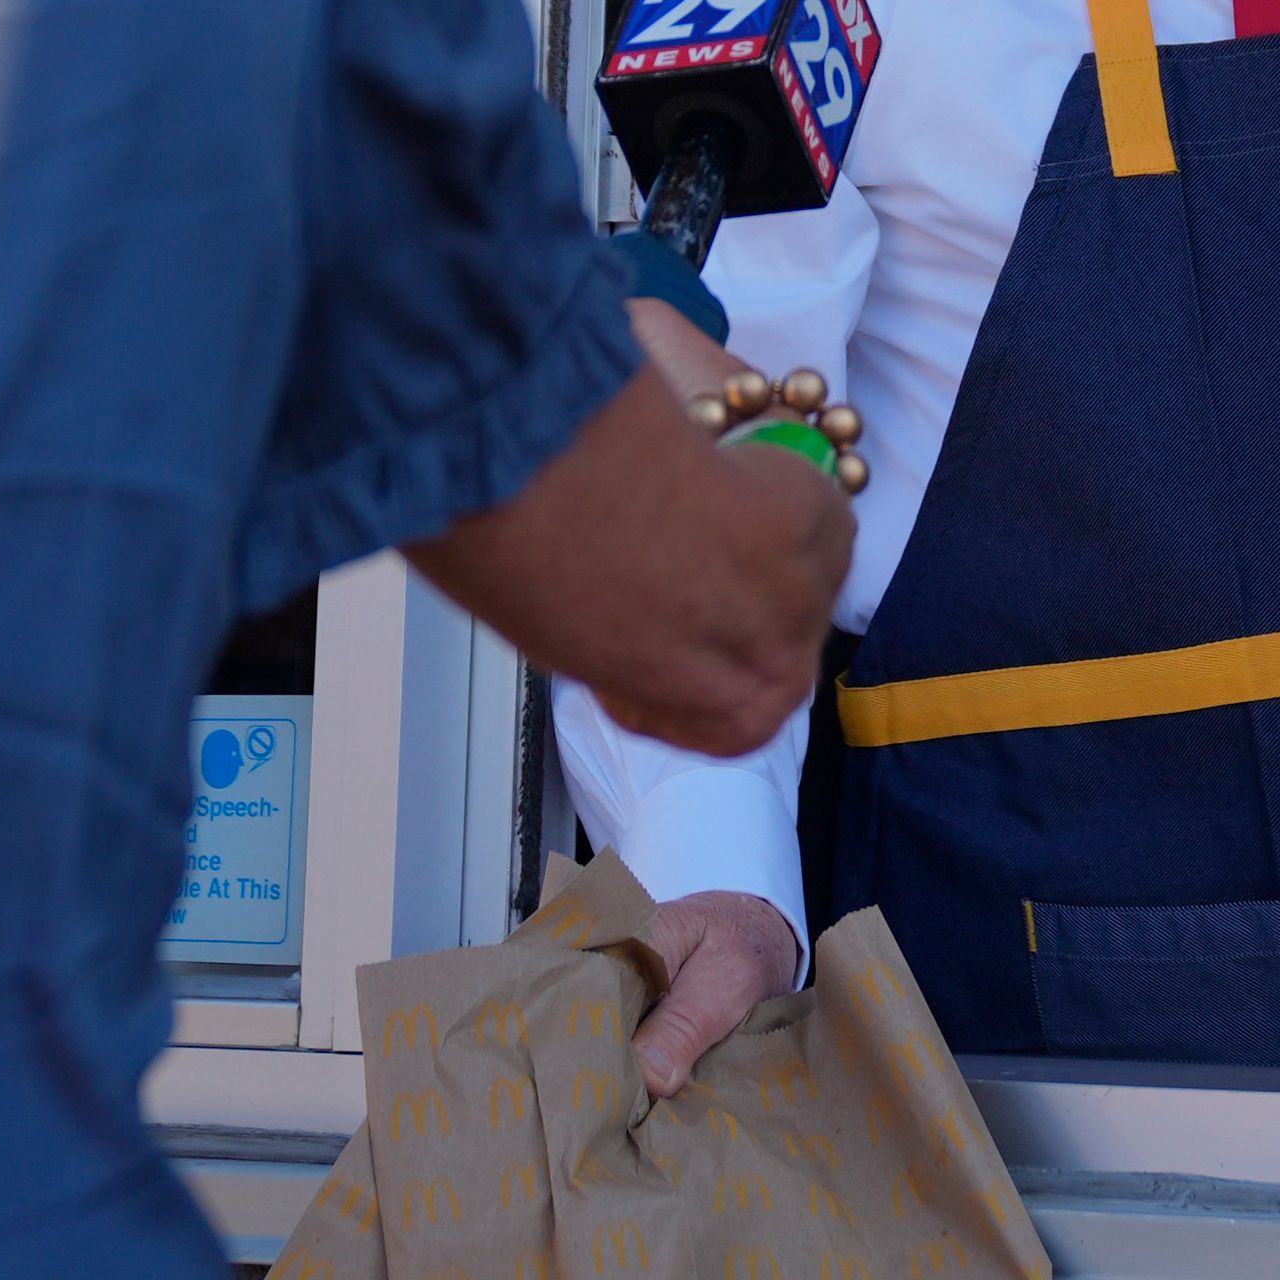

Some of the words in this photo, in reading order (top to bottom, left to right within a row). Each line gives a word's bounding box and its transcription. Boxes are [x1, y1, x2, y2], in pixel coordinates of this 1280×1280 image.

[617, 41, 753, 70] NEWS
[779, 58, 832, 178] NEWS
[208, 878, 230, 898] At
[237, 878, 281, 900] This
